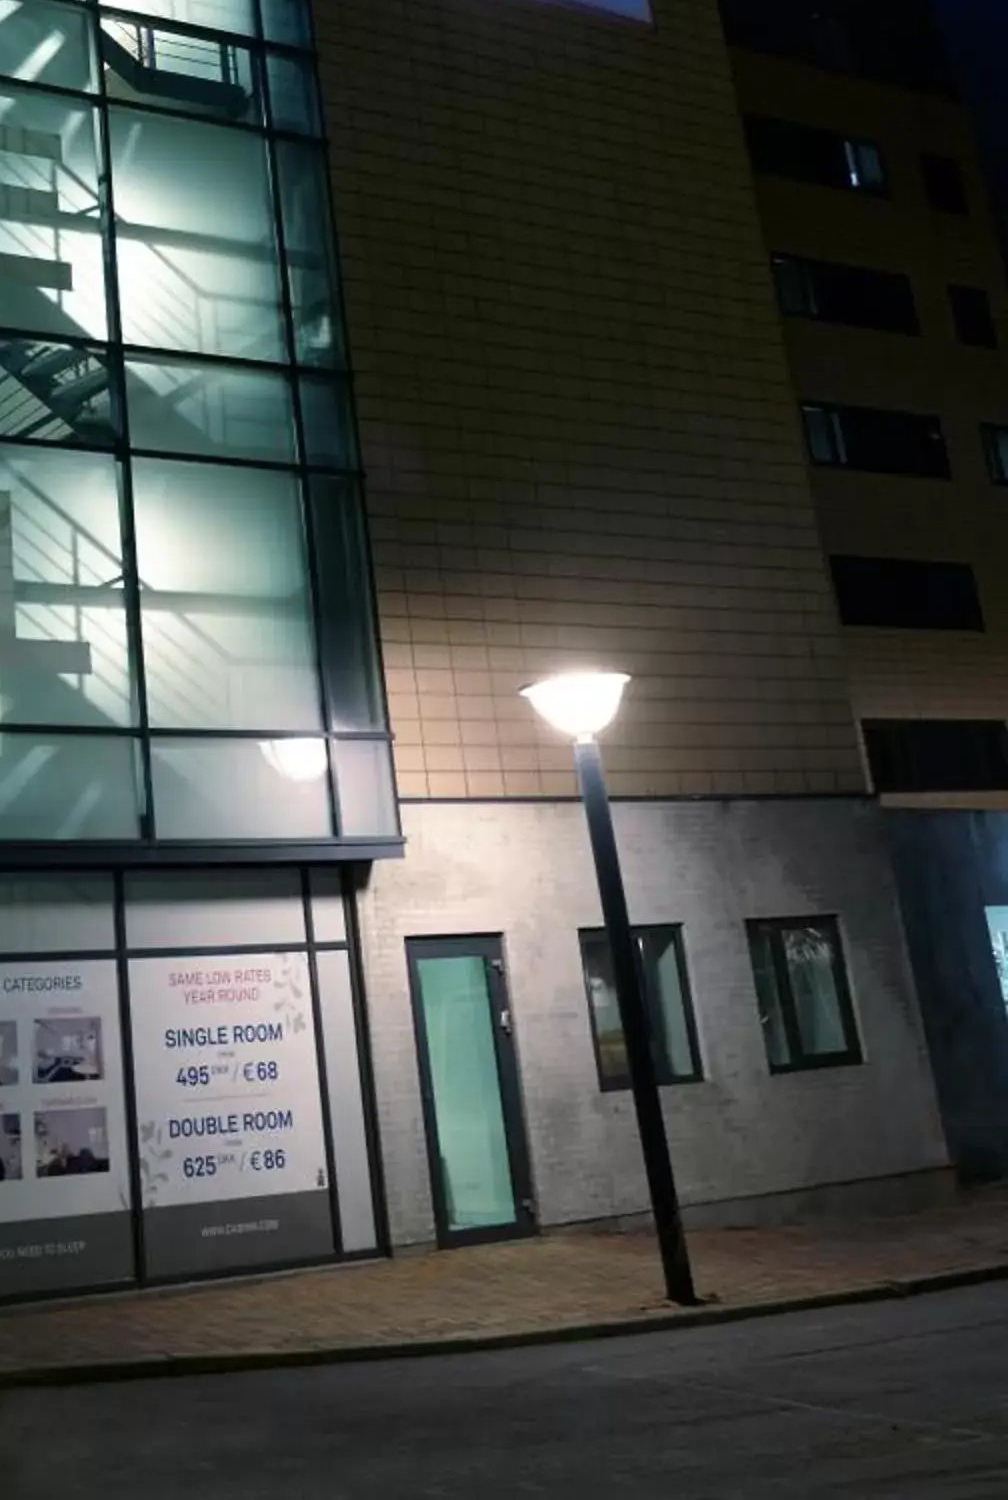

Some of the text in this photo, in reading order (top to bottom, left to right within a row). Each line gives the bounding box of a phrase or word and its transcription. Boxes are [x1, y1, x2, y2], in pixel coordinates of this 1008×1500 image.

[3, 976, 83, 993] CATEGORIES
[168, 969, 272, 987] SAME LOW RATES
[184, 987, 260, 1004] YEAR ROUND
[165, 1022, 284, 1049] SINGLE ROOM
[176, 1065, 210, 1087] 495
[169, 1110, 293, 1138] DOUBLE ROOM
[183, 1155, 217, 1178] 625
